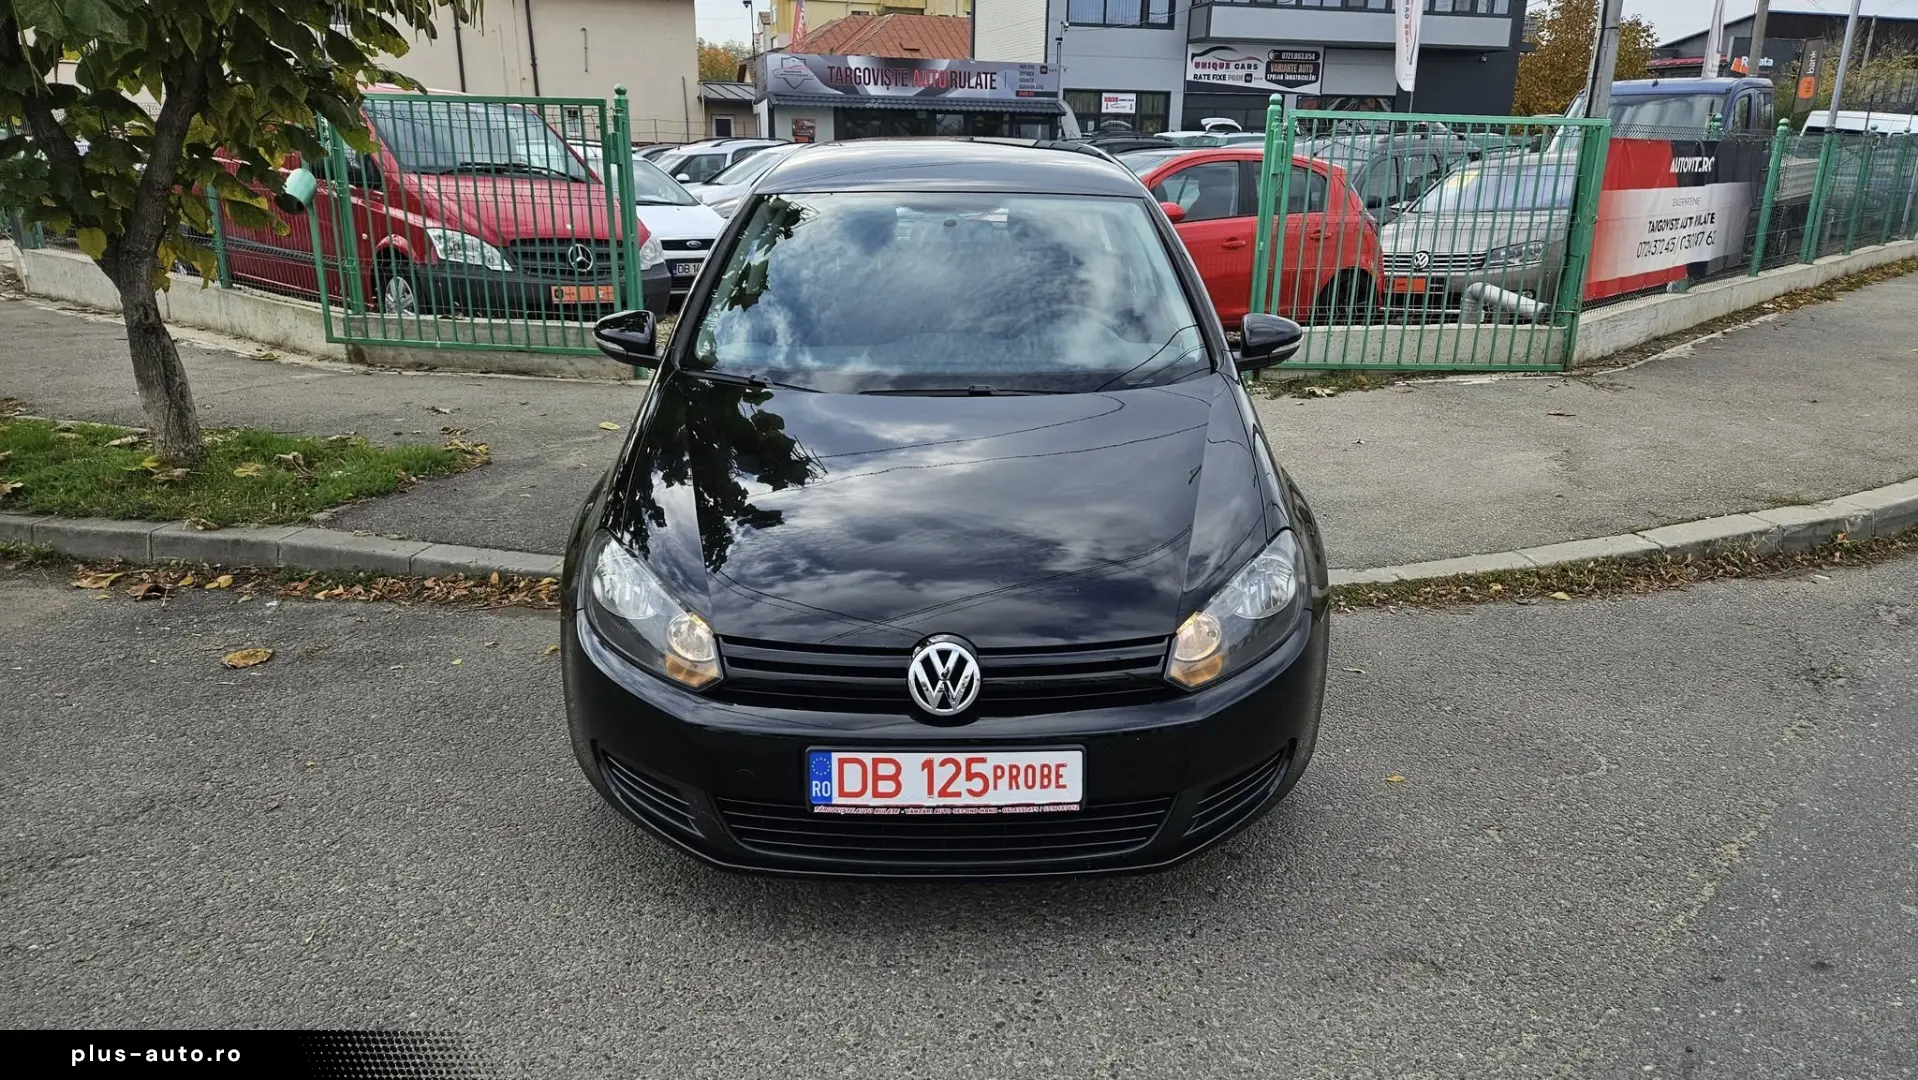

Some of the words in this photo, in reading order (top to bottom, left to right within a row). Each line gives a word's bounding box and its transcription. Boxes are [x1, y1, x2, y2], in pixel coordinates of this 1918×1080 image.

[1194, 61, 1231, 71] UNIQUE
[1741, 55, 1774, 67] Rata
[1806, 50, 1817, 74] bank
[913, 68, 948, 89] AUTO
[951, 70, 998, 90] RULATE
[1193, 73, 1211, 81] RATE
[1212, 73, 1227, 81] FIXE
[811, 780, 831, 798] RO
[837, 756, 903, 799] DB
[920, 756, 990, 799] 125
[992, 762, 1068, 791] PROBE
